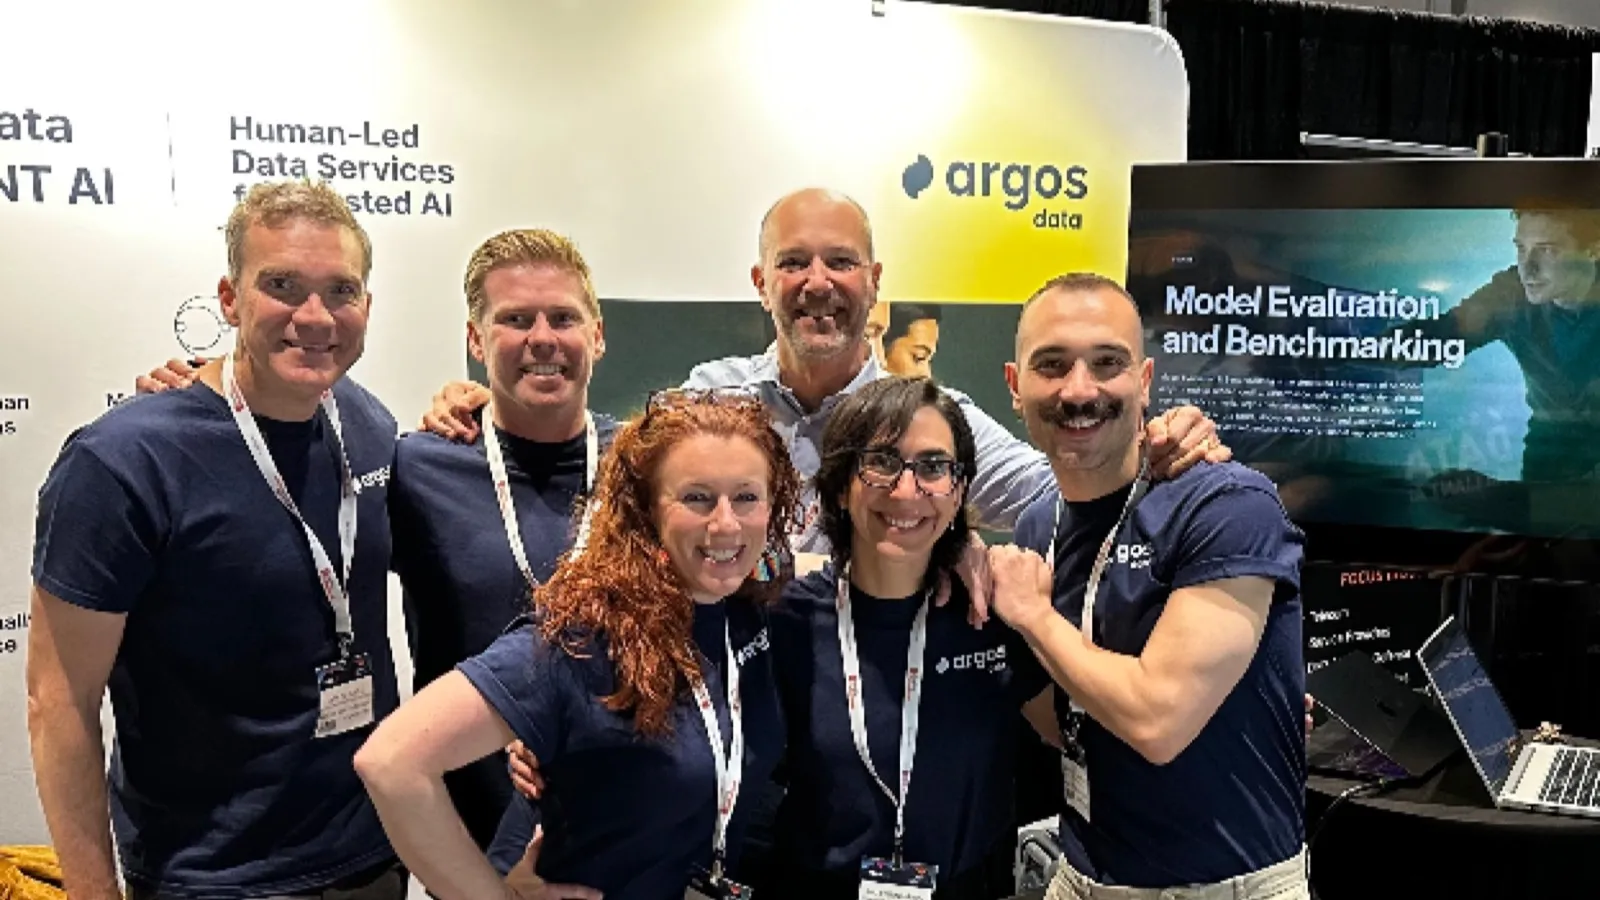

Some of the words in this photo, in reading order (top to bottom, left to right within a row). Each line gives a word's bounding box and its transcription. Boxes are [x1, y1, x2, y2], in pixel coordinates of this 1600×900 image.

[230, 116, 419, 148] Human-Led
[232, 149, 306, 178] Data
[317, 152, 455, 184] Services
[68, 167, 114, 205] AI
[945, 161, 1088, 210] argos
[420, 192, 452, 217] AI
[1032, 208, 1083, 229] data
[1165, 285, 1262, 316] Model
[1267, 285, 1440, 321] Evaluation
[1162, 324, 1221, 354] and
[1225, 325, 1466, 369] Benchmarking
